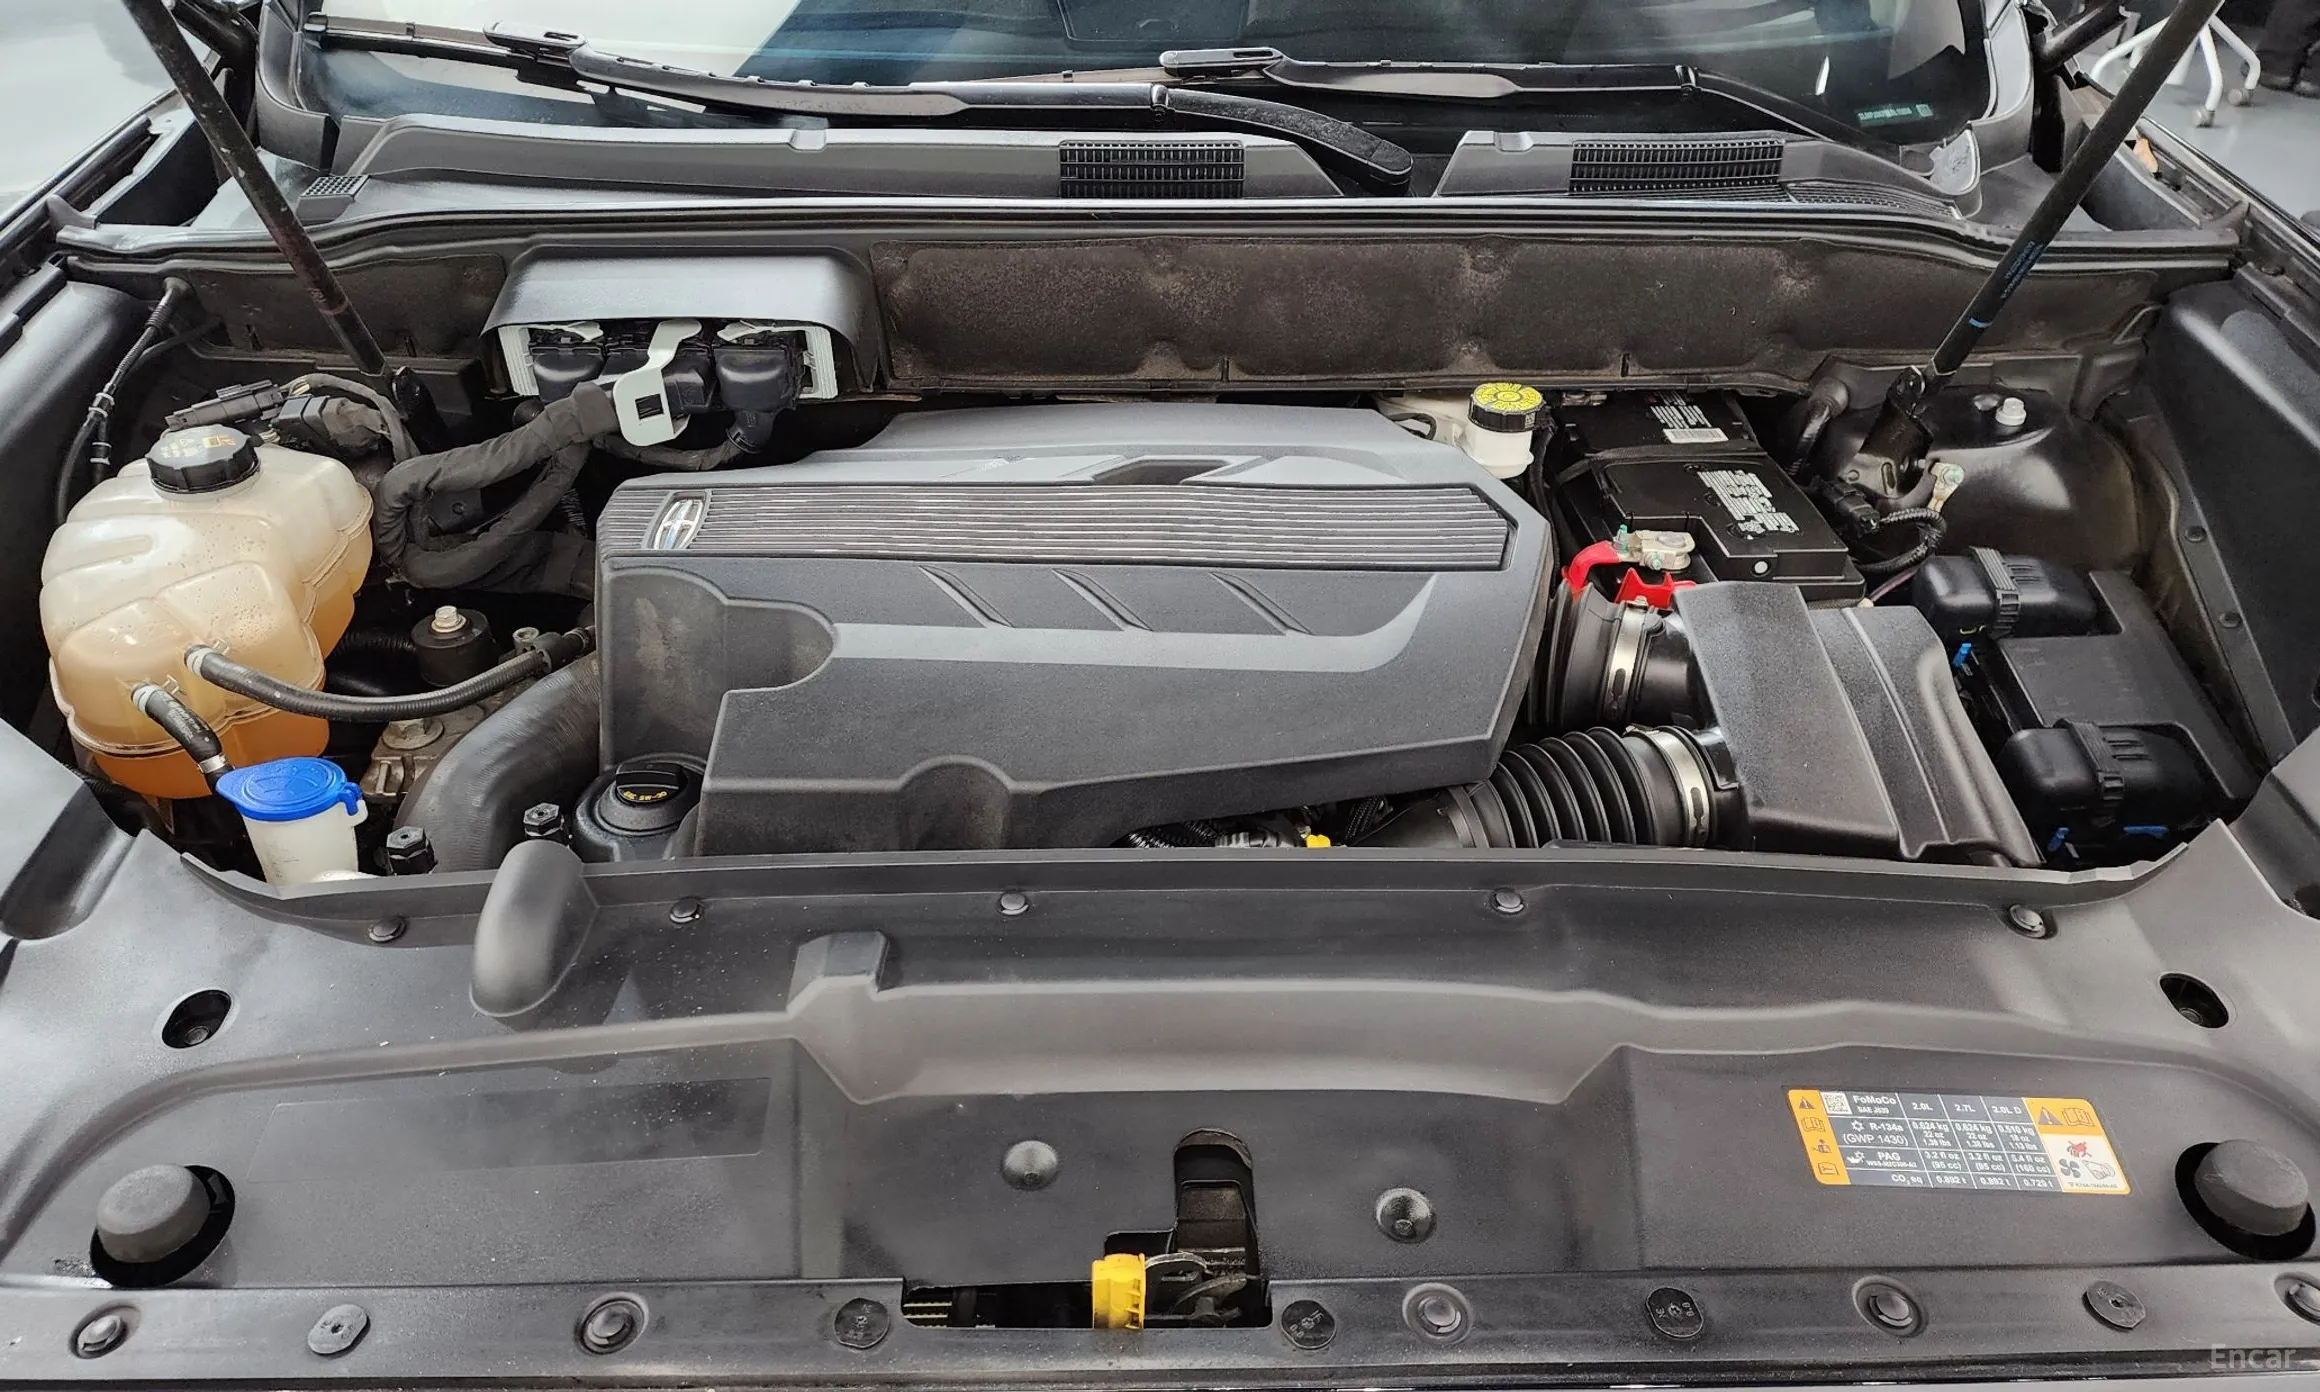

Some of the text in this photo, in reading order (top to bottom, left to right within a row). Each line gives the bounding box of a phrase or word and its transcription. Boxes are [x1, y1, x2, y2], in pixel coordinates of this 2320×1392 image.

[1853, 1095, 1896, 1105] FoMoCo
[1912, 1102, 1933, 1110] 2.0L
[1955, 1104, 1976, 1112] 2.7L
[1993, 1106, 2013, 1114] 2.0L
[1869, 1122, 1904, 1132] R-134a
[1937, 1123, 1949, 1132] kg
[1955, 1123, 1993, 1134] 0.624 kg
[2023, 1126, 2035, 1136] kg
[1843, 1133, 1908, 1146] (GWP 1430)
[2026, 1143, 2038, 1151] lbs
[1877, 1152, 1901, 1161] PAG
[1925, 1151, 1938, 1159] 3.2
[1939, 1151, 1947, 1159] fl
[1932, 1161, 1962, 1171] (95 cc)
[1992, 1163, 2006, 1172] cc)
[2036, 1165, 2051, 1174] cc)
[1911, 1176, 1923, 1185] eq
